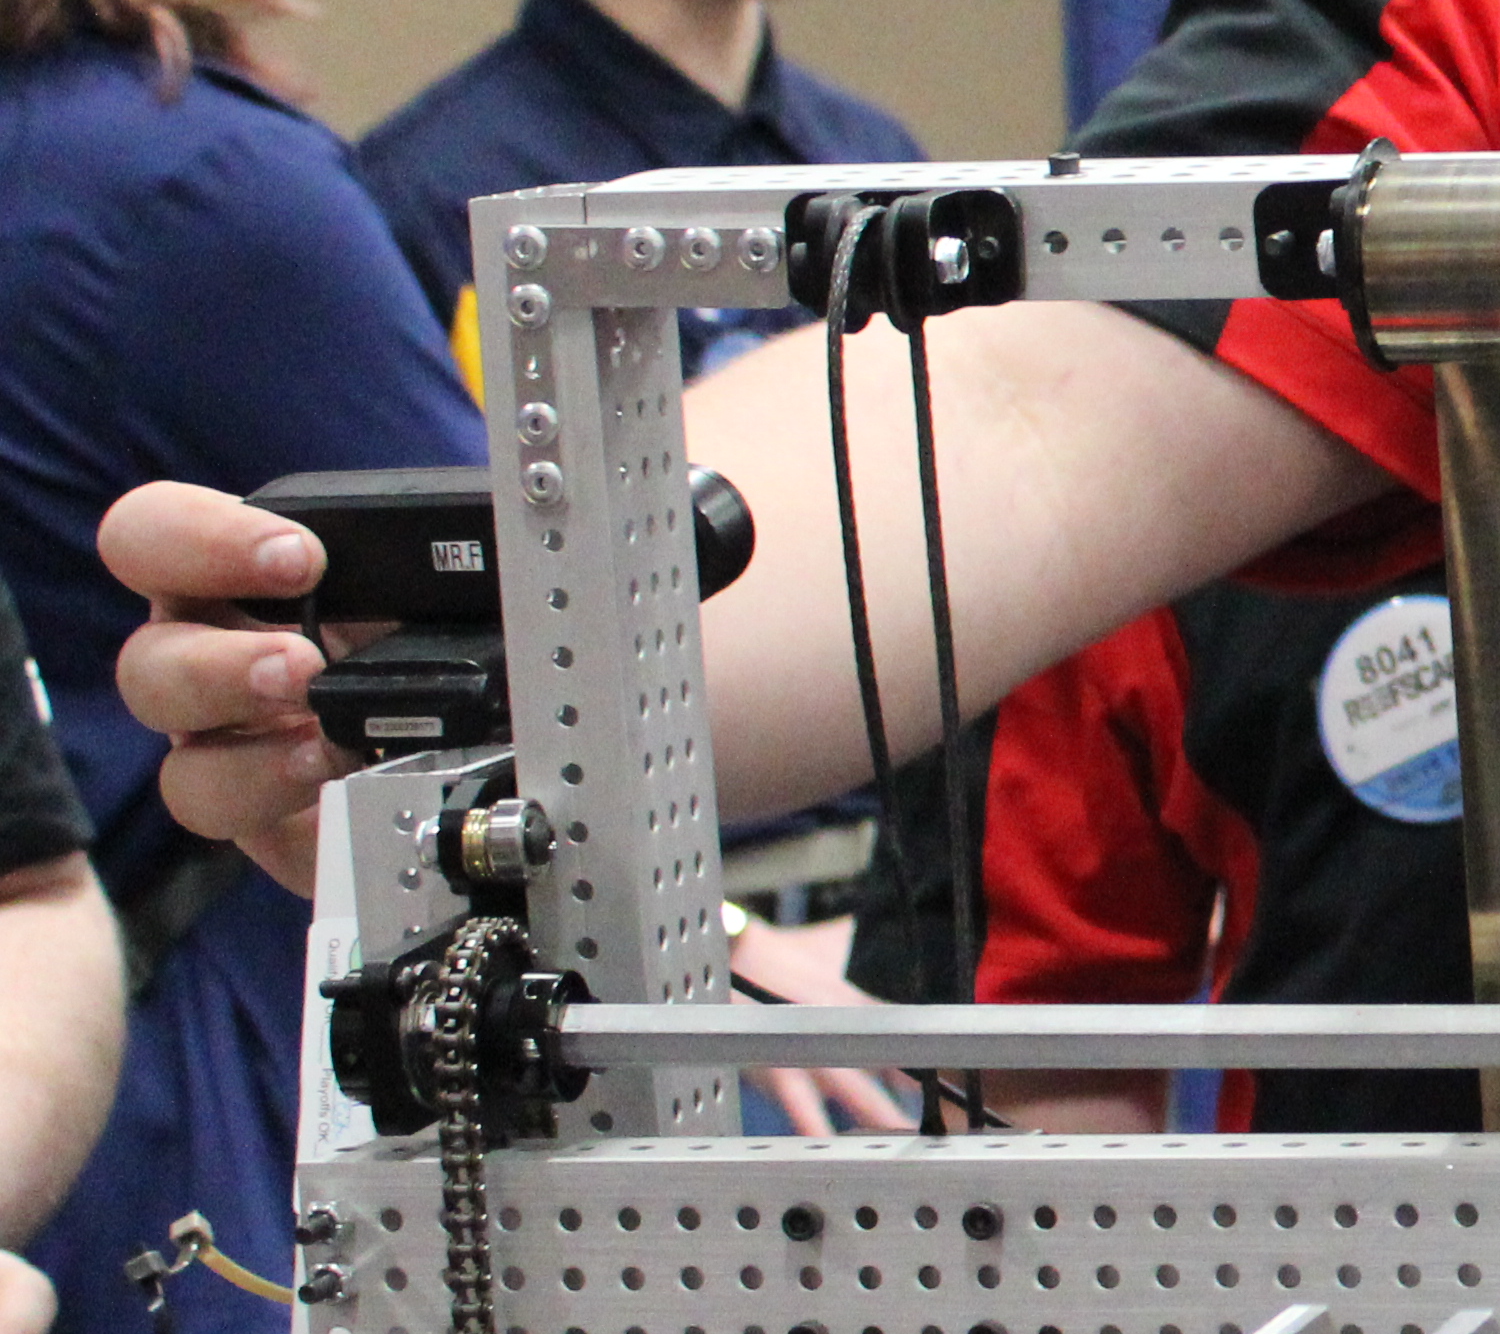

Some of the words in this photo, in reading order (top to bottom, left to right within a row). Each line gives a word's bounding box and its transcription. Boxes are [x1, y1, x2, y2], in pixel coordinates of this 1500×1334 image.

[1356, 625, 1436, 685] 8041
[1343, 652, 1454, 727] REEFSCA
[317, 1068, 334, 1118] Playoffs
